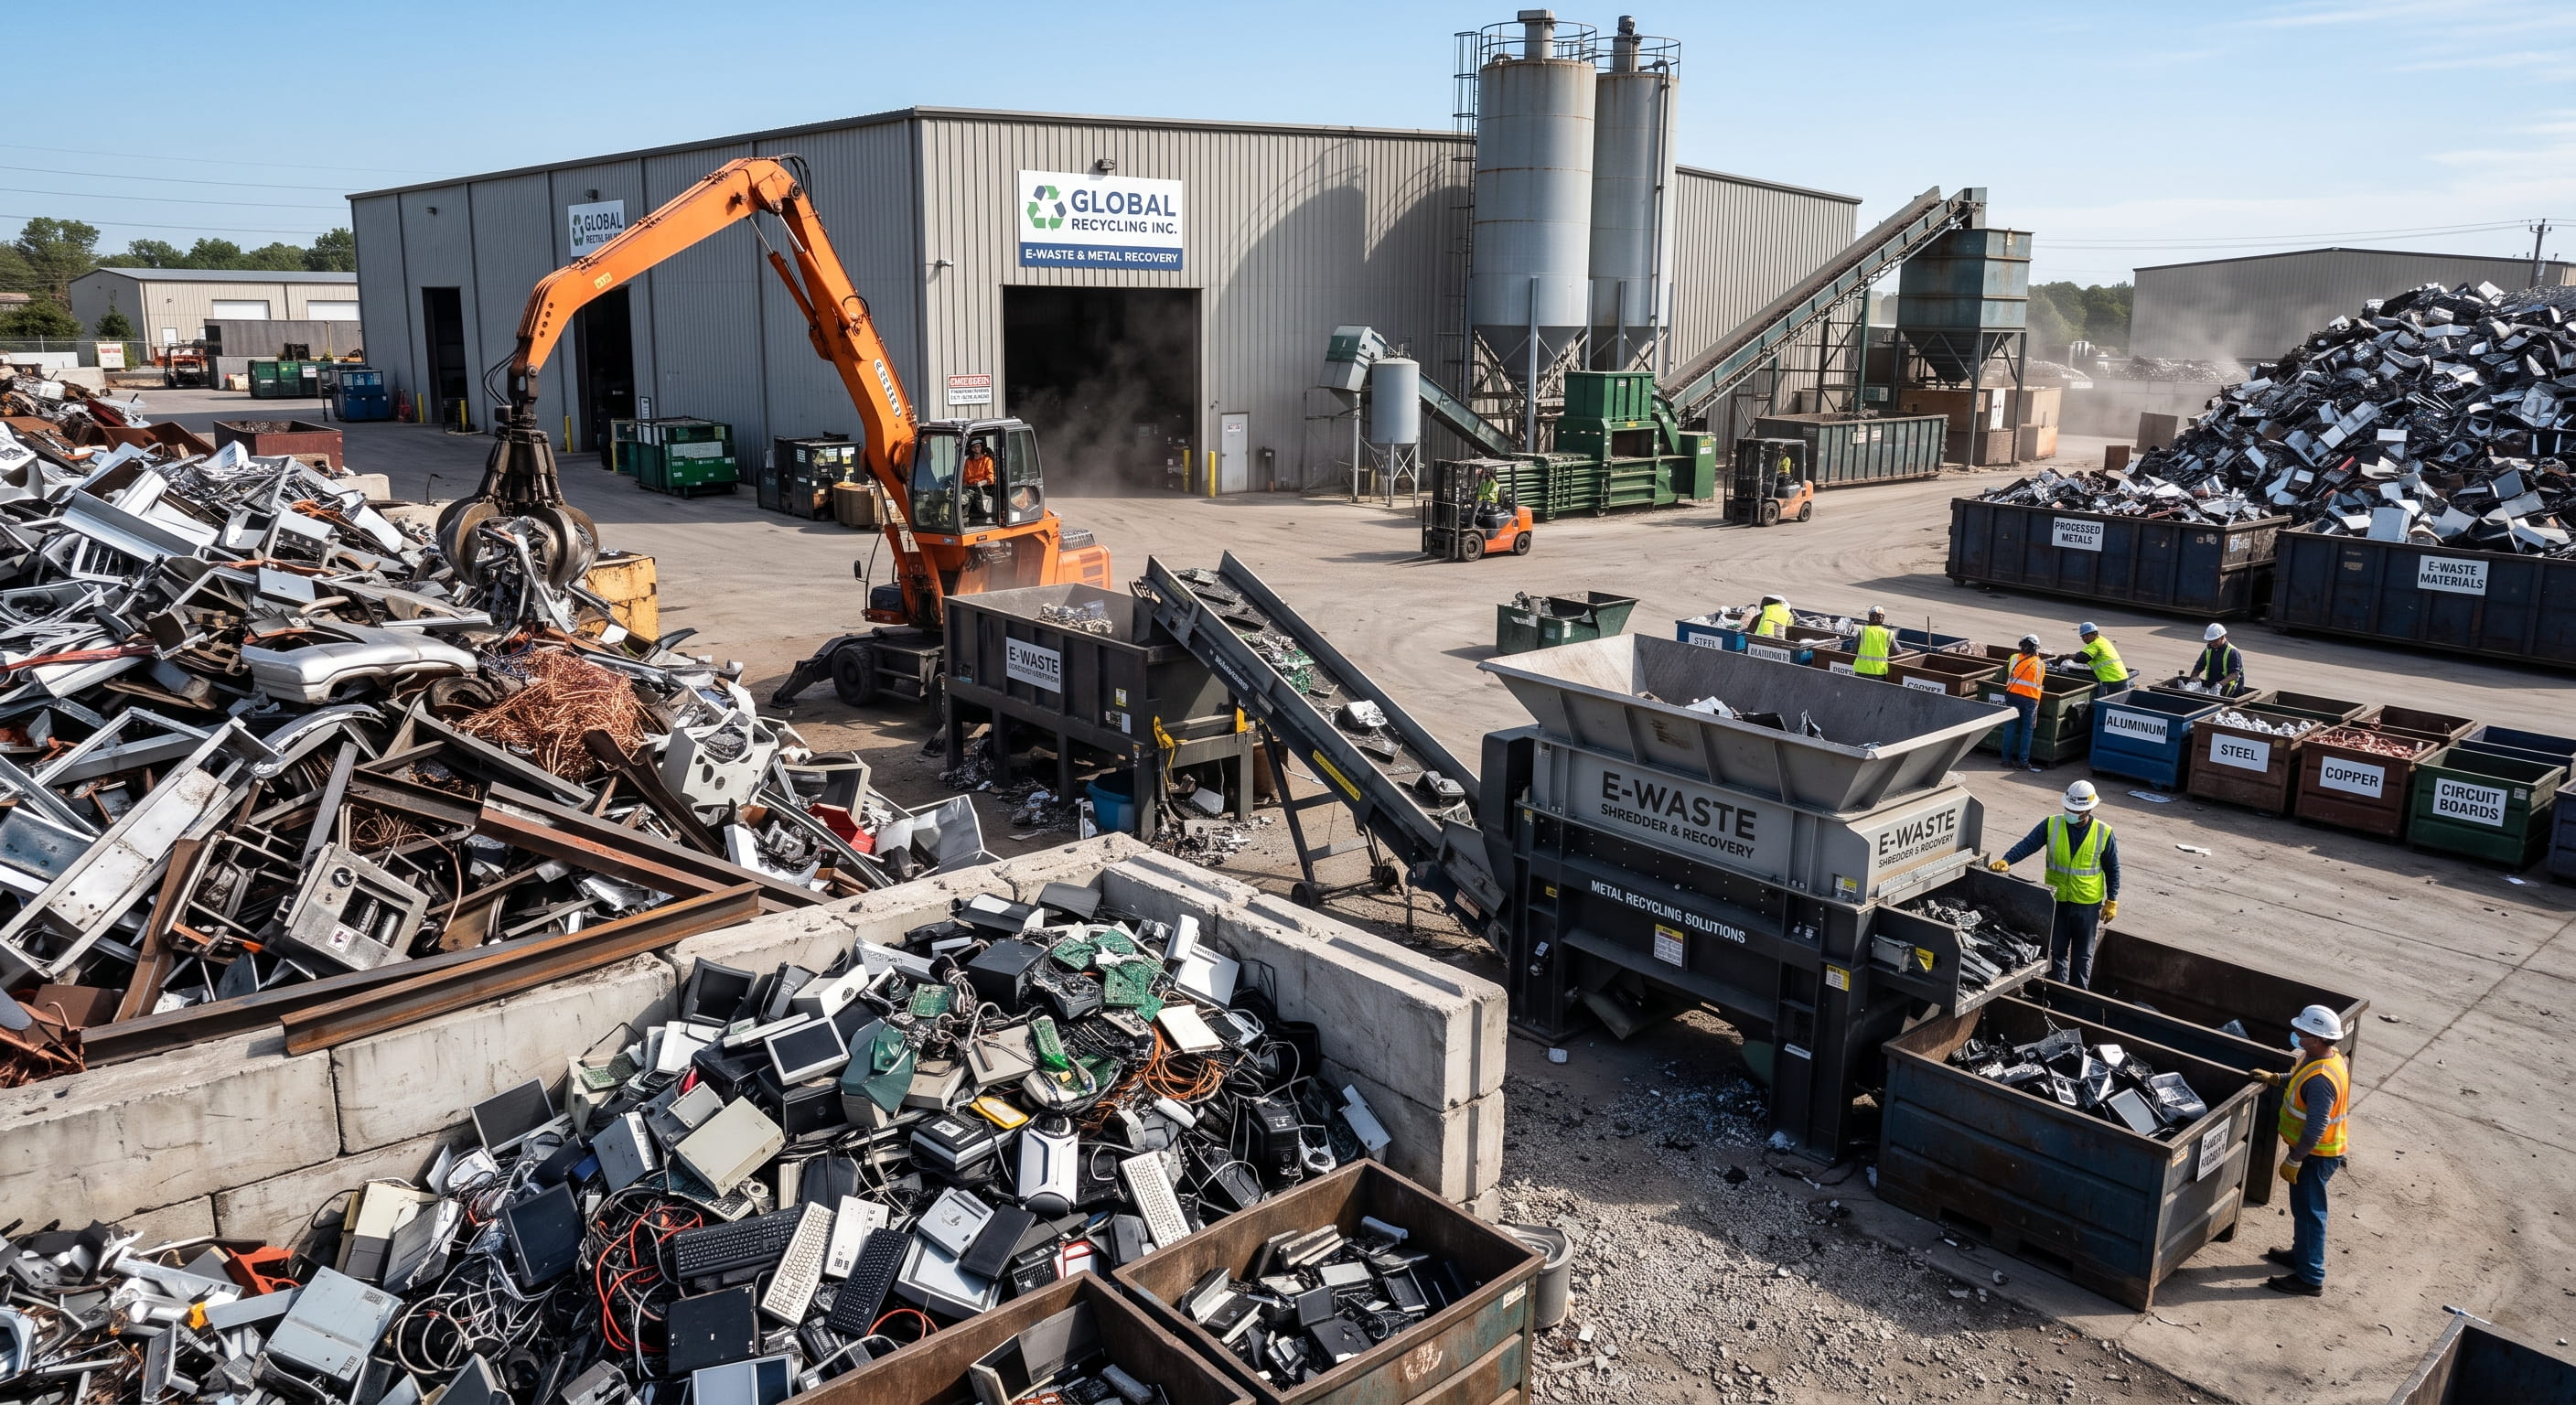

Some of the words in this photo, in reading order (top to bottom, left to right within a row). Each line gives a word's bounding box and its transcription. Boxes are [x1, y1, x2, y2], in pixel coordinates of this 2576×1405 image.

[1071, 189, 1176, 217] GLOBAL
[585, 212, 623, 231] GLOBAL
[1071, 218, 1147, 233] RECYCLING
[1152, 222, 1177, 234] INC.
[1025, 249, 1074, 260] E-WASTE
[1077, 251, 1086, 261] &
[1088, 251, 1122, 262] METAL
[1125, 252, 1178, 263] RECOVERY
[2055, 521, 2101, 535] PROCESSED
[2061, 532, 2093, 545] METALS
[2428, 561, 2477, 576] E-WASTE
[2420, 573, 2485, 589] MATERIALS
[1009, 646, 1058, 675] E-WASTE
[2106, 715, 2166, 737] ALUMINUM
[2220, 744, 2259, 761] STEEL
[2324, 767, 2378, 788] COPPER
[2441, 783, 2500, 805] CIRCUIT
[1602, 770, 1757, 842] E-WASTE
[2439, 798, 2499, 820] BOARDS
[1601, 803, 1668, 833] SHREDDER
[1669, 824, 1680, 838] &
[1682, 827, 1755, 859] RECOVERY
[1878, 808, 1956, 856] E-WASTE
[1591, 880, 1624, 902] METAL
[1626, 892, 1682, 922] RECYCLING
[1685, 912, 1746, 944] SOLUTIONS
